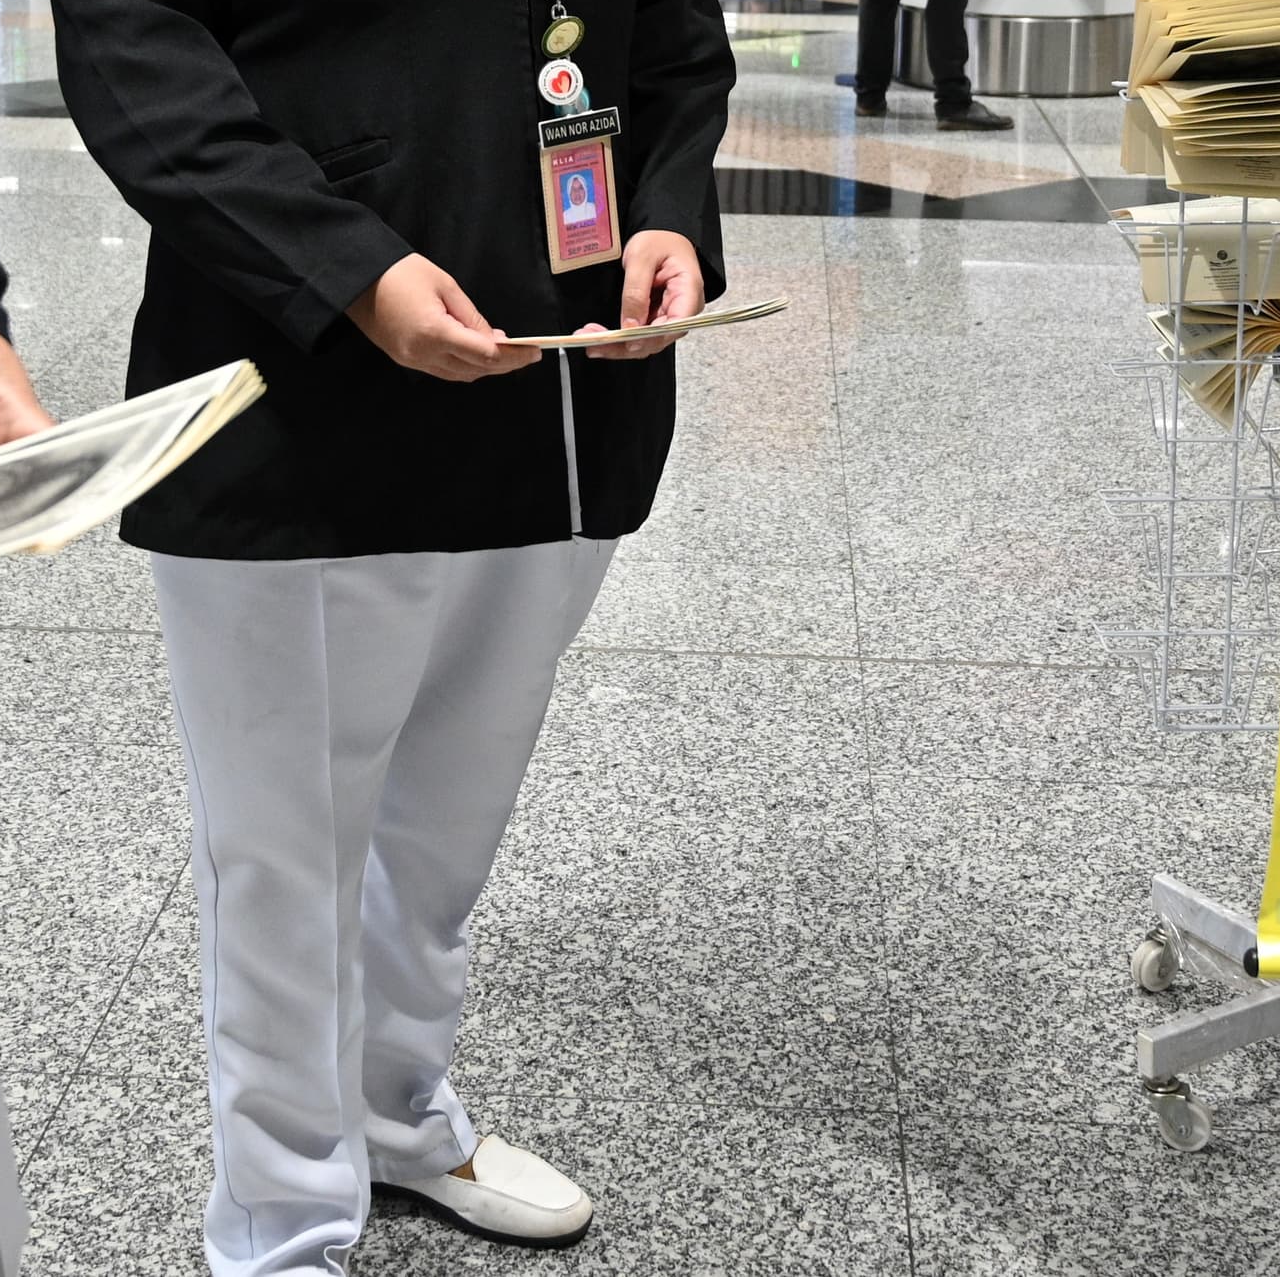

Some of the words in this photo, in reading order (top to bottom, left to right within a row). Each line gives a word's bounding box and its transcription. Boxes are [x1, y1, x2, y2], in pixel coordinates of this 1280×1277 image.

[545, 126, 567, 141] WAN
[569, 122, 589, 135] NOR
[590, 116, 616, 131] AZIDA
[552, 156, 574, 166] KLIA
